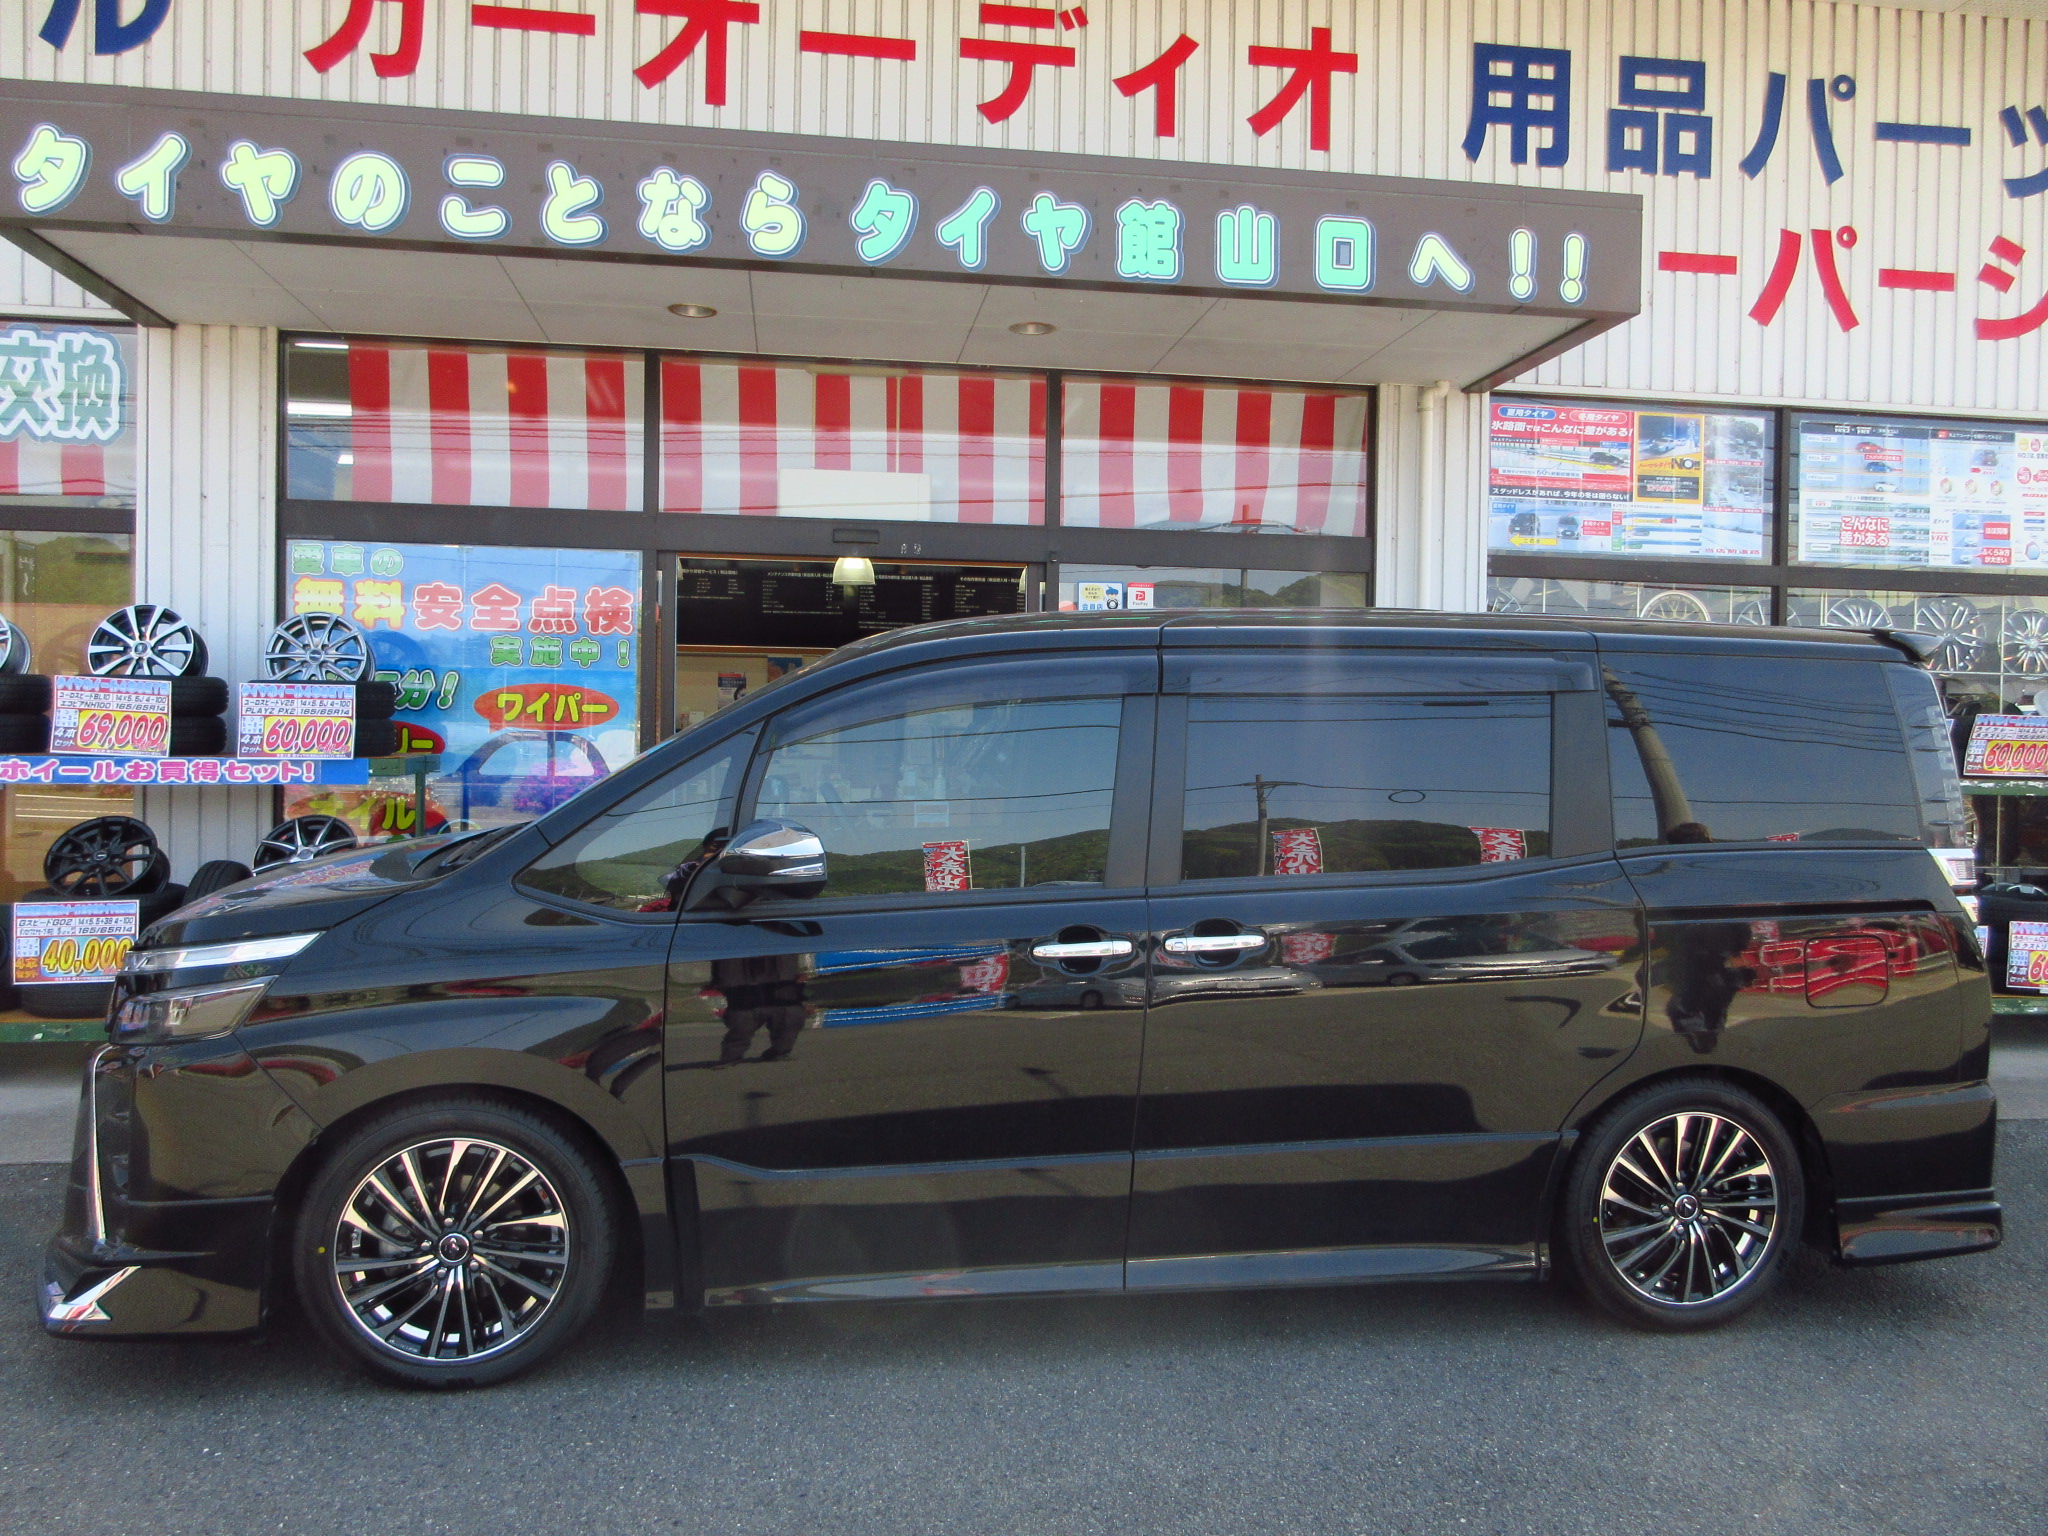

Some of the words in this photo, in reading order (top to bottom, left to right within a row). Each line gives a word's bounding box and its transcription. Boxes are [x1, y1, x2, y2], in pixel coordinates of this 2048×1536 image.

[1840, 531, 1889, 546] 差がある
[1841, 516, 1889, 531] こんなに
[292, 544, 404, 577] 愛車の
[292, 578, 635, 636] 無料安全点検
[490, 635, 630, 669] 実施中!
[278, 707, 296, 715] PX2
[497, 693, 608, 723] ワイパー
[79, 712, 168, 749] 69,000
[265, 718, 351, 754] 60,000
[0, 759, 316, 783] ホイールお買得セット!
[1985, 742, 2048, 770] 60,000
[19, 919, 73, 927] GスピードG02
[42, 936, 134, 974] 40,000
